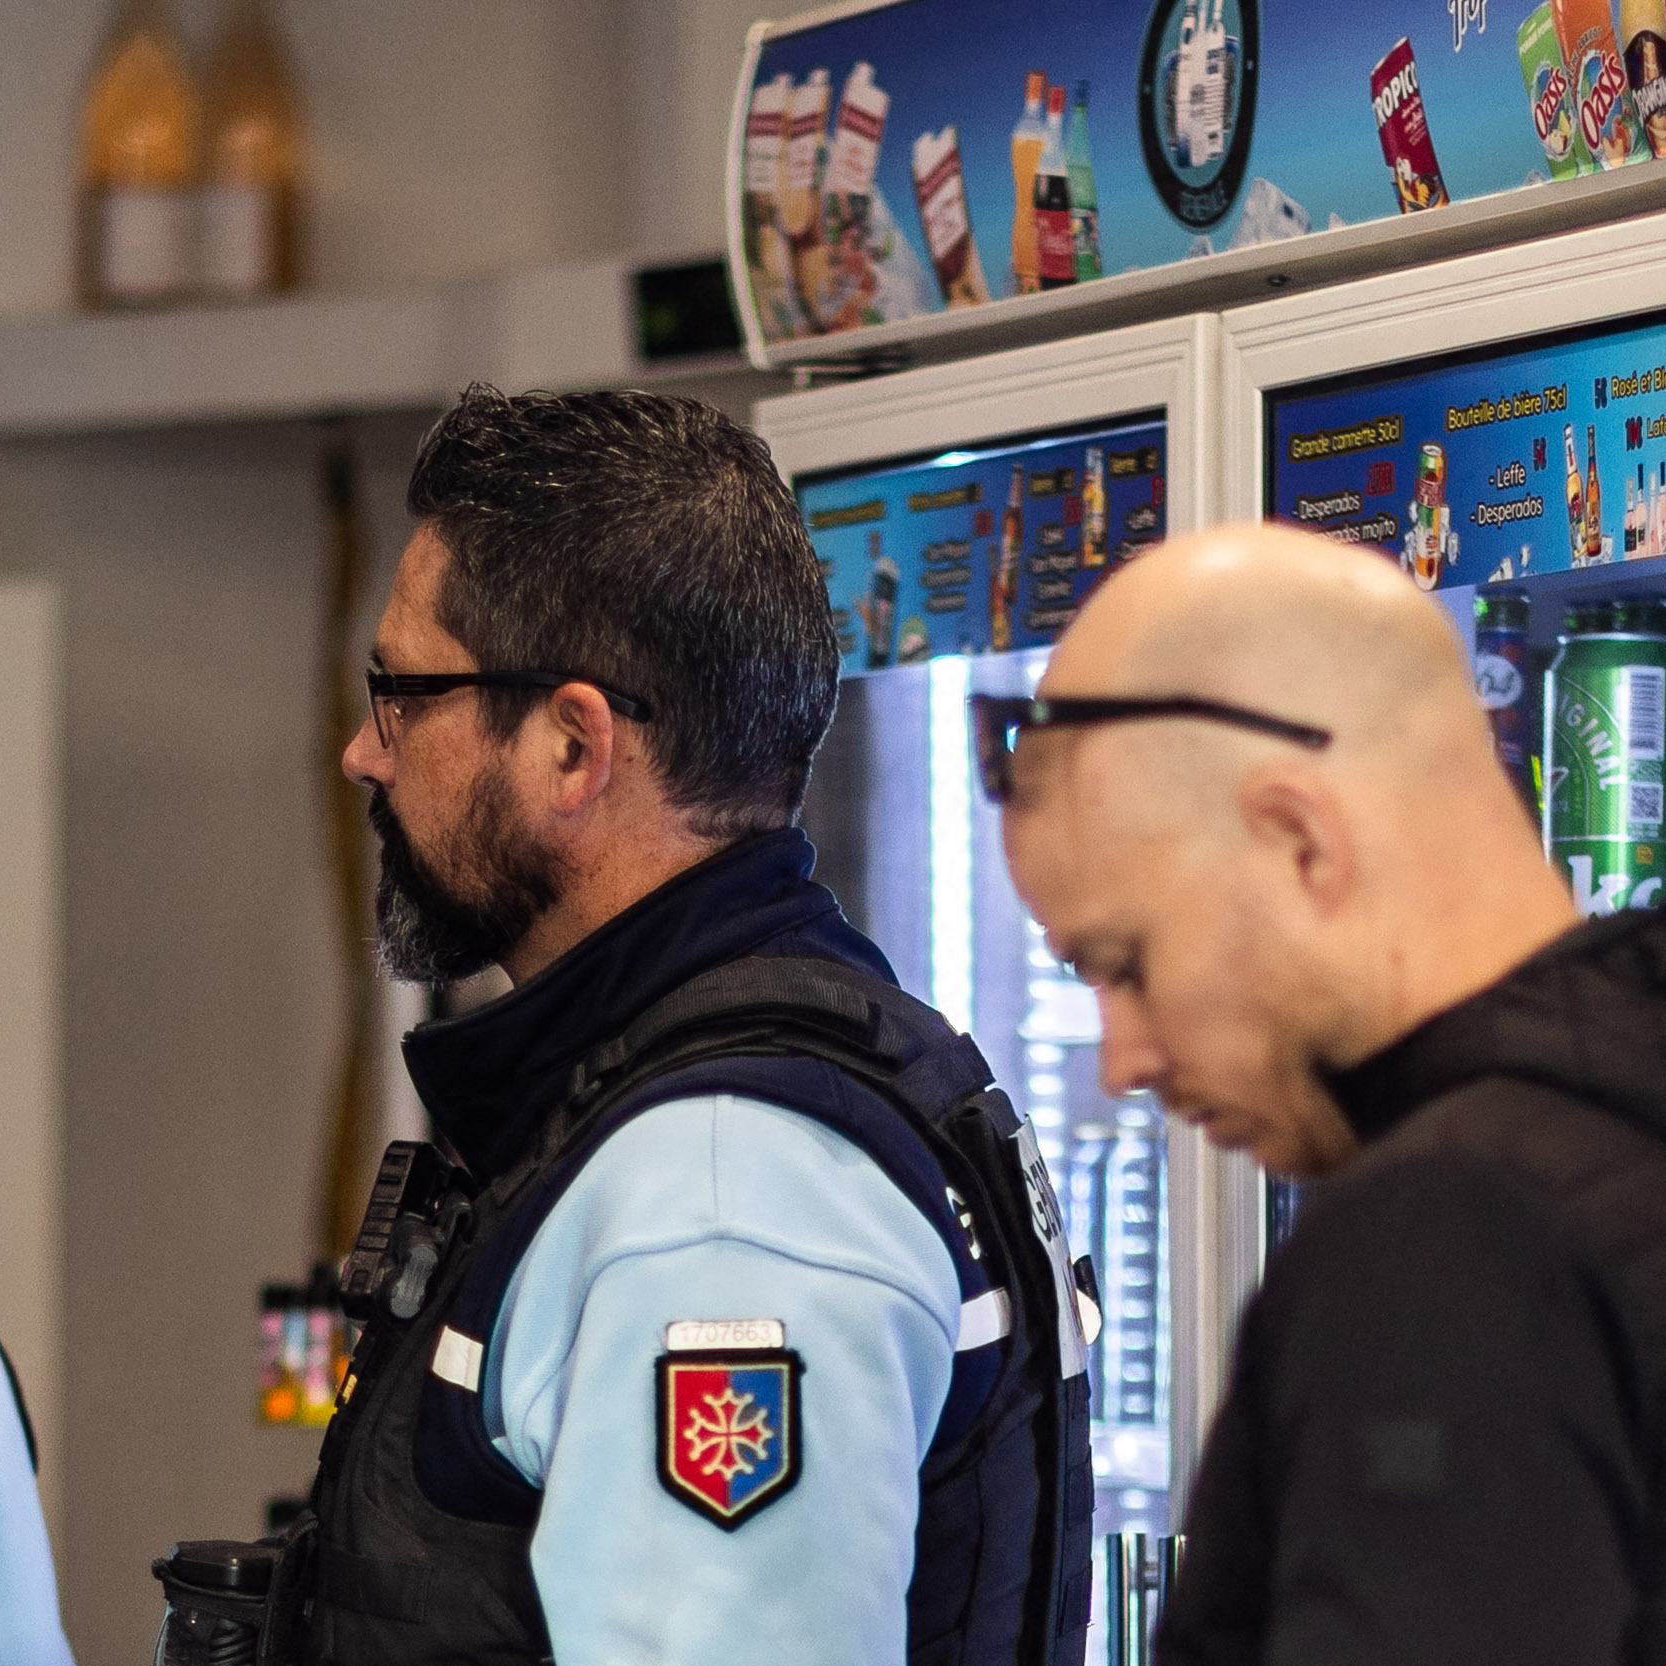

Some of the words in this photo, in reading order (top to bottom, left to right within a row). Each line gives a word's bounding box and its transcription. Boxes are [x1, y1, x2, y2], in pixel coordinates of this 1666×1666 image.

[1534, 67, 1568, 141] Oasis
[1580, 51, 1626, 150] Oasis
[1611, 372, 1638, 400] Rosé
[1640, 370, 1652, 394] et
[1445, 397, 1496, 432] Bouteille
[1496, 394, 1512, 423] de
[1513, 390, 1542, 420] bière
[1543, 383, 1567, 413] 75cl
[1496, 460, 1527, 488] Leffe
[1299, 492, 1362, 522] Desperados
[1476, 494, 1544, 530] Desperados
